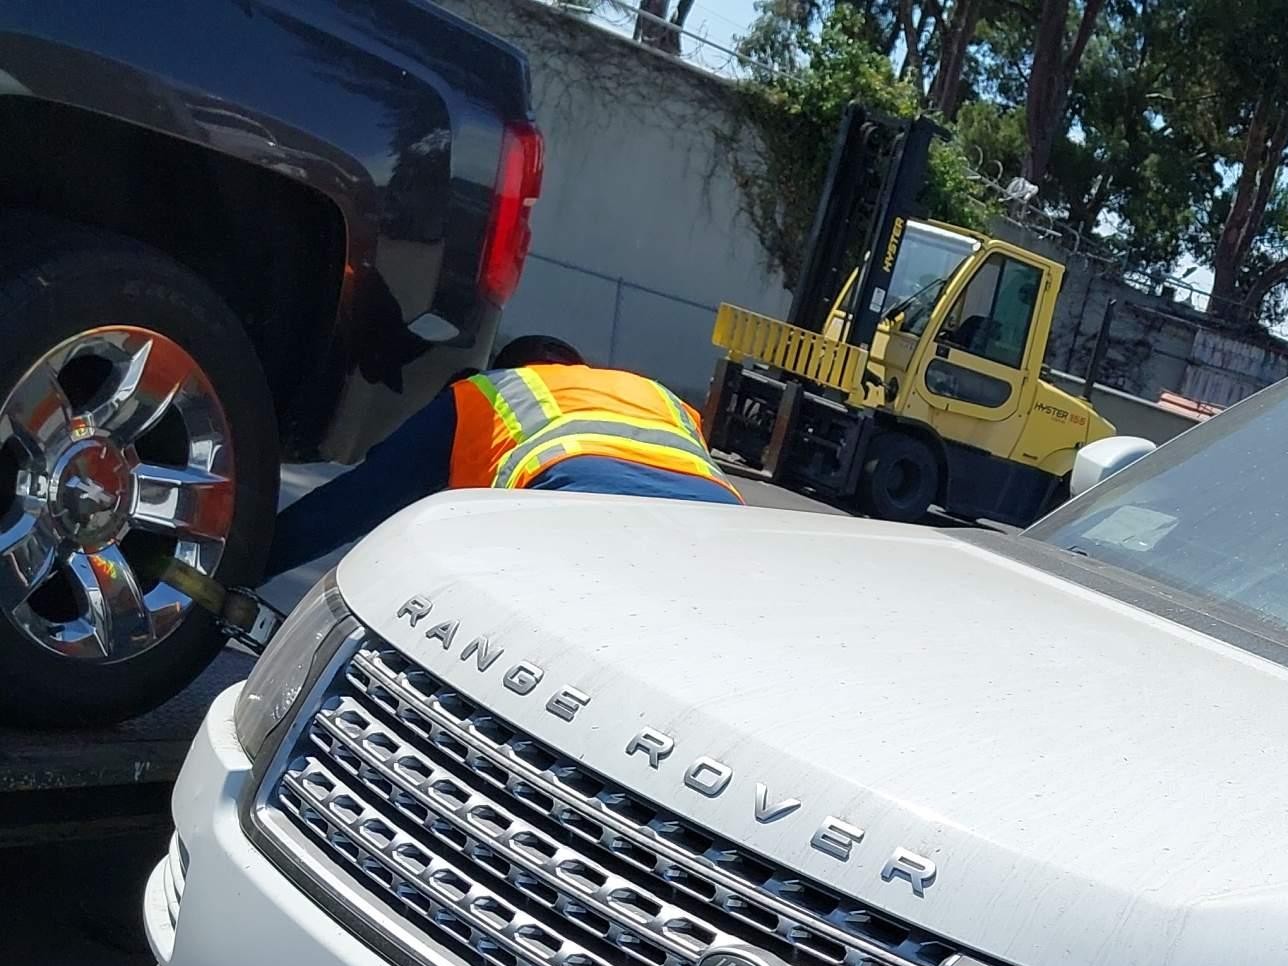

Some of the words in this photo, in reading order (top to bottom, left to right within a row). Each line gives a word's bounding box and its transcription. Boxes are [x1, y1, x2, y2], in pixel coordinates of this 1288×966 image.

[882, 216, 904, 272] HYSTER
[1034, 401, 1069, 420] HYSTER
[397, 594, 591, 722] RANGE
[626, 726, 938, 897] ROVER
